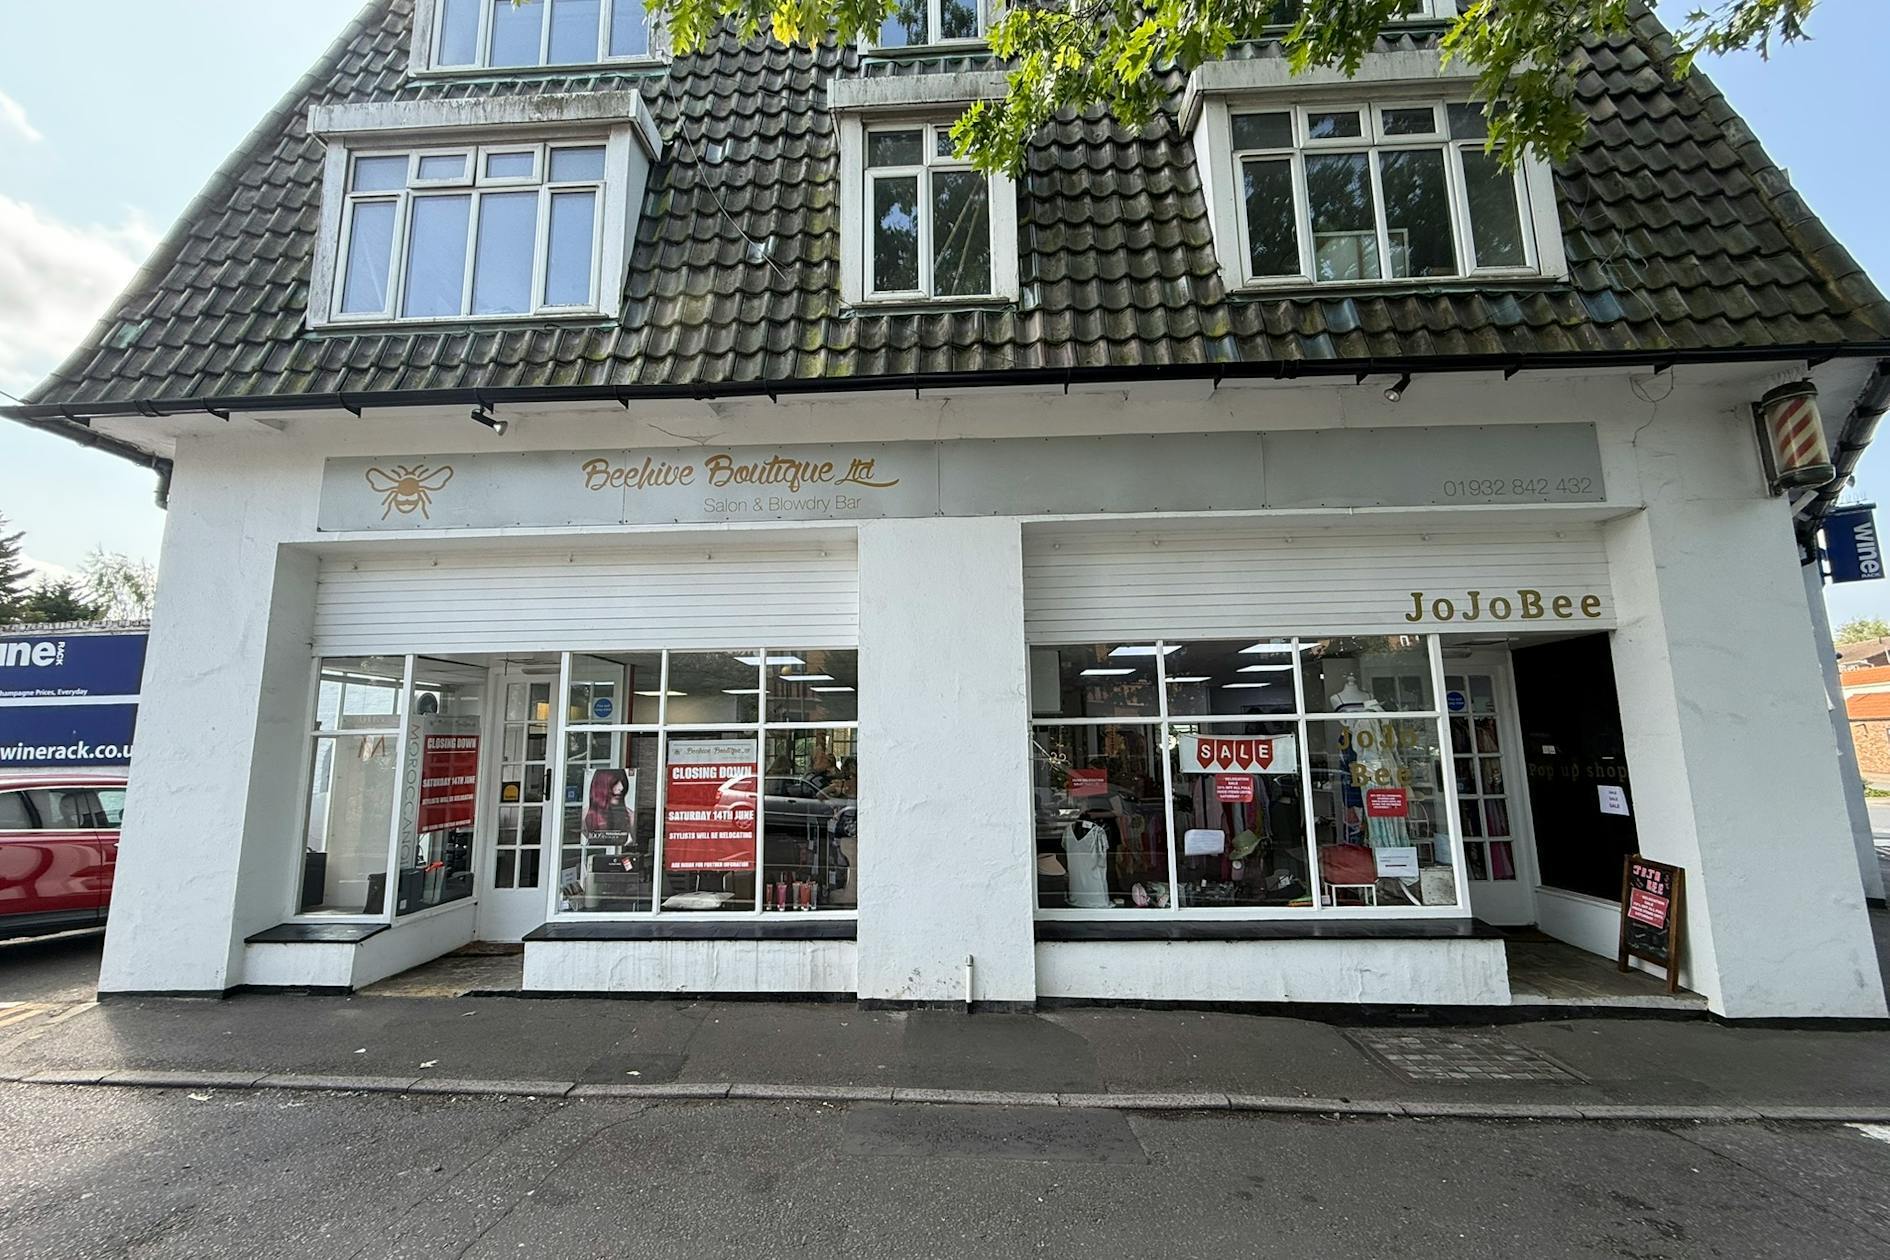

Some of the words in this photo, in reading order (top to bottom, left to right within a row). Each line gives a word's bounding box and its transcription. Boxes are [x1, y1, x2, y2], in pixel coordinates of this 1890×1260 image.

[581, 456, 696, 491] Beehive
[704, 453, 836, 493] Boutique
[836, 457, 900, 488] Ltd
[1443, 479, 1506, 497] 01932
[1512, 478, 1549, 496] 842
[1556, 477, 1593, 495] 432
[703, 497, 748, 514] Salon
[752, 497, 764, 512] &
[769, 495, 831, 514] Blowdry
[835, 495, 862, 511] Bar
[1853, 521, 1880, 574] wine
[1405, 589, 1602, 622] JoJoBee
[0, 641, 57, 667] ine
[56, 641, 66, 666] RACK
[0, 689, 35, 698] hampagne
[57, 687, 88, 696] Everyday
[0, 741, 133, 760] winerack.co.u
[427, 737, 457, 749] CLOSING
[457, 737, 477, 749] DOWN
[1200, 744, 1270, 759] SALE
[672, 766, 717, 780] CLOSING
[719, 766, 752, 779] DOWN
[1348, 761, 1413, 787] Bee
[1528, 763, 1554, 780] Pop
[1560, 764, 1580, 782] up
[1586, 762, 1628, 783] shop
[400, 722, 421, 866] MOROCCANOI
[668, 810, 711, 821] SATURDAY
[713, 810, 733, 821] 14TH
[734, 810, 754, 820] JUNE
[669, 832, 696, 840] STYLISTS
[696, 832, 710, 840] WILL
[719, 831, 753, 839] RELOCATING
